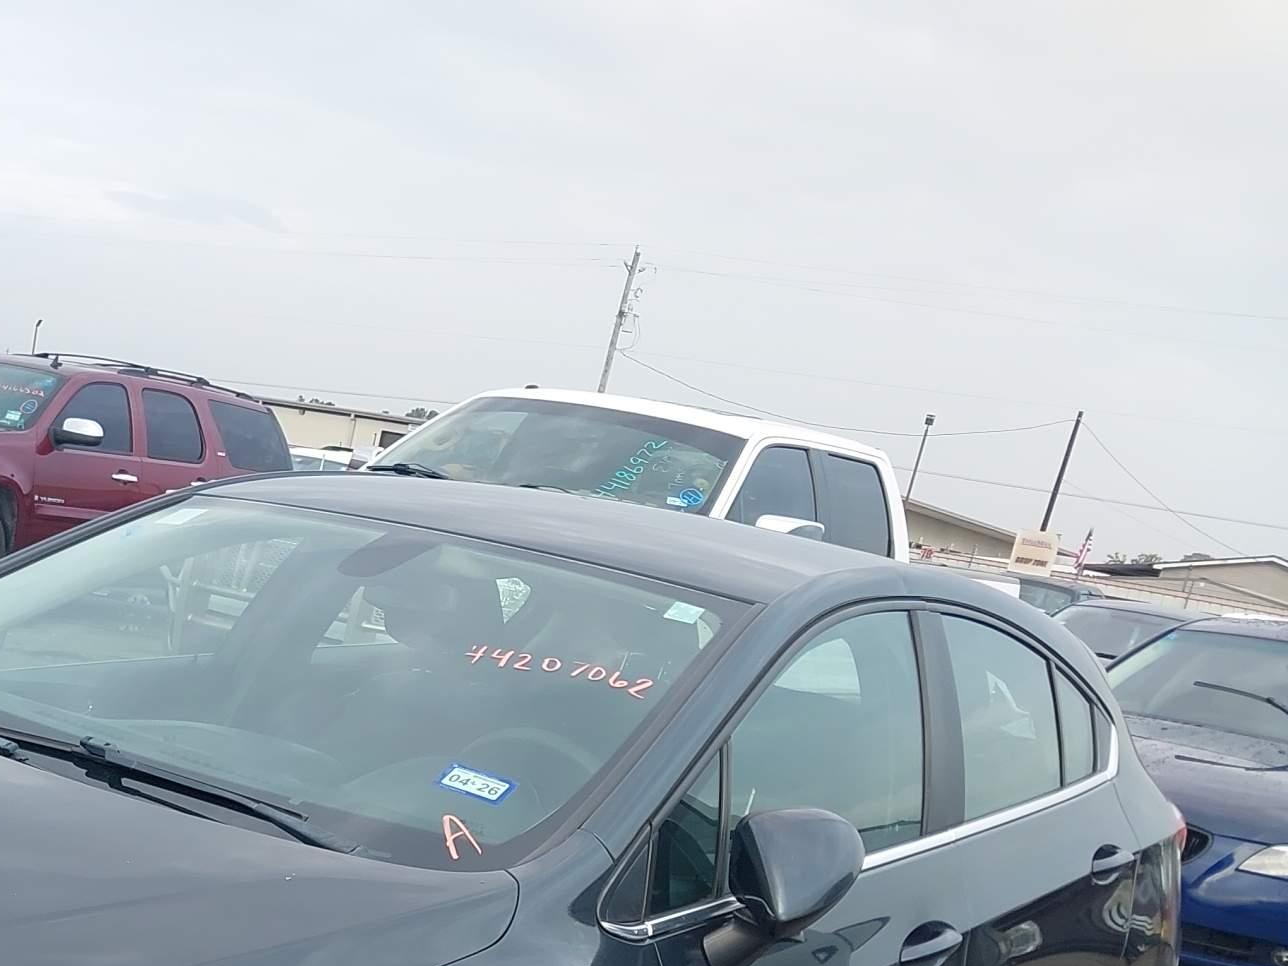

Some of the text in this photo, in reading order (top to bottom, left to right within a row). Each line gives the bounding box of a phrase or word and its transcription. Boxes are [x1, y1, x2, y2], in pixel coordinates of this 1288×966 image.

[592, 440, 668, 499] 44186972
[464, 645, 654, 699] 44207062
[442, 814, 483, 860] A
